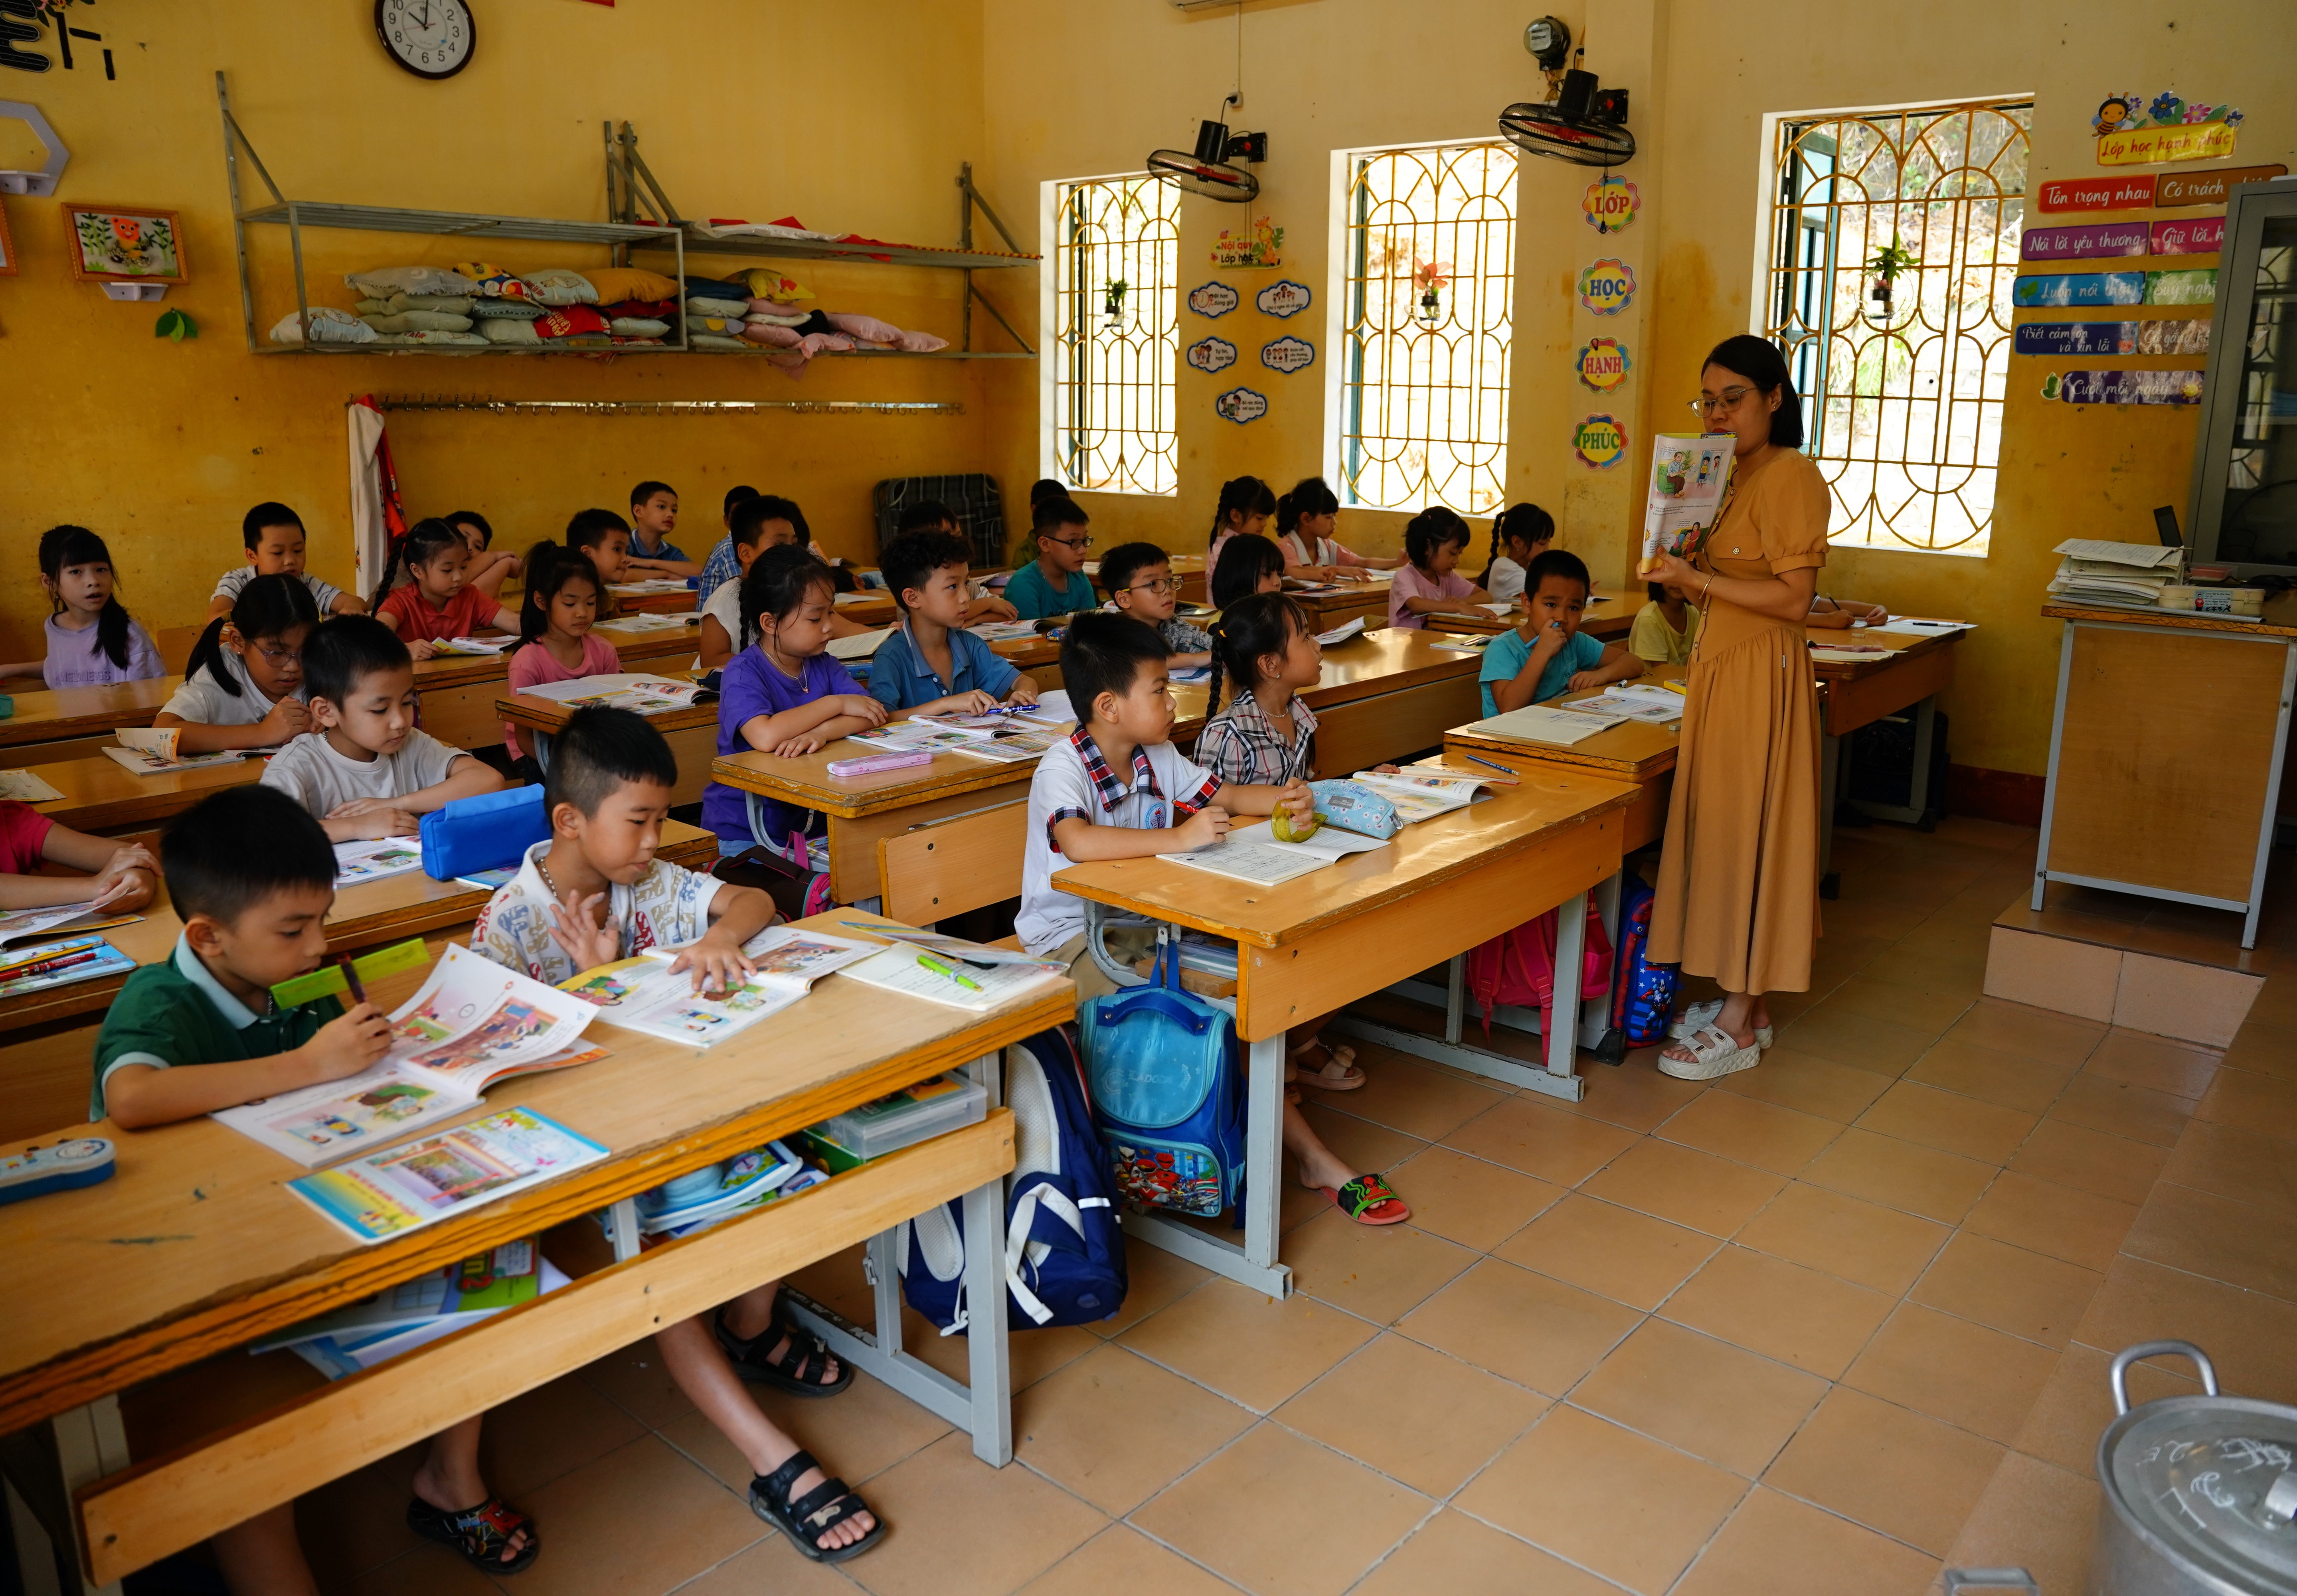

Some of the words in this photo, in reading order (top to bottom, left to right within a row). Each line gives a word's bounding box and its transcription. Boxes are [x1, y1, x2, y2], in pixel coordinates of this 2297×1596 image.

[389, 12, 396, 24] 9
[447, 9, 454, 21] 2
[395, 32, 402, 43] 8
[453, 26, 459, 38] 3
[406, 44, 413, 55] 7
[449, 42, 455, 53] 4
[422, 52, 429, 63] 6
[438, 51, 445, 61] 5
[2102, 141, 2124, 159] Lớp
[2130, 138, 2152, 155] học
[2158, 133, 2191, 153] hạnh
[2198, 130, 2231, 152] phúc
[2164, 181, 2184, 198] Có
[2188, 178, 2225, 196] trách
[1594, 191, 1629, 214] LỚP
[2046, 186, 2068, 204] Tôn
[2075, 191, 2110, 207] trọng
[2115, 184, 2151, 201] nhau
[2029, 235, 2049, 252] Nói
[2055, 235, 2069, 250] lời
[2074, 235, 2094, 254] yêu
[2099, 232, 2141, 251] thương
[2162, 227, 2185, 250] Giữ
[2192, 226, 2210, 242] lời
[1221, 241, 1235, 252] Nội
[1221, 253, 1235, 265] Lớp
[1590, 279, 1625, 300] HỌC
[2079, 282, 2098, 297] nói
[2022, 326, 2044, 339] Biết
[2049, 328, 2070, 339] cảm
[2059, 342, 2072, 353] và
[2098, 338, 2110, 352] lỗi
[1585, 356, 1622, 378] HẠNH
[1582, 429, 1619, 450] PHÚC
